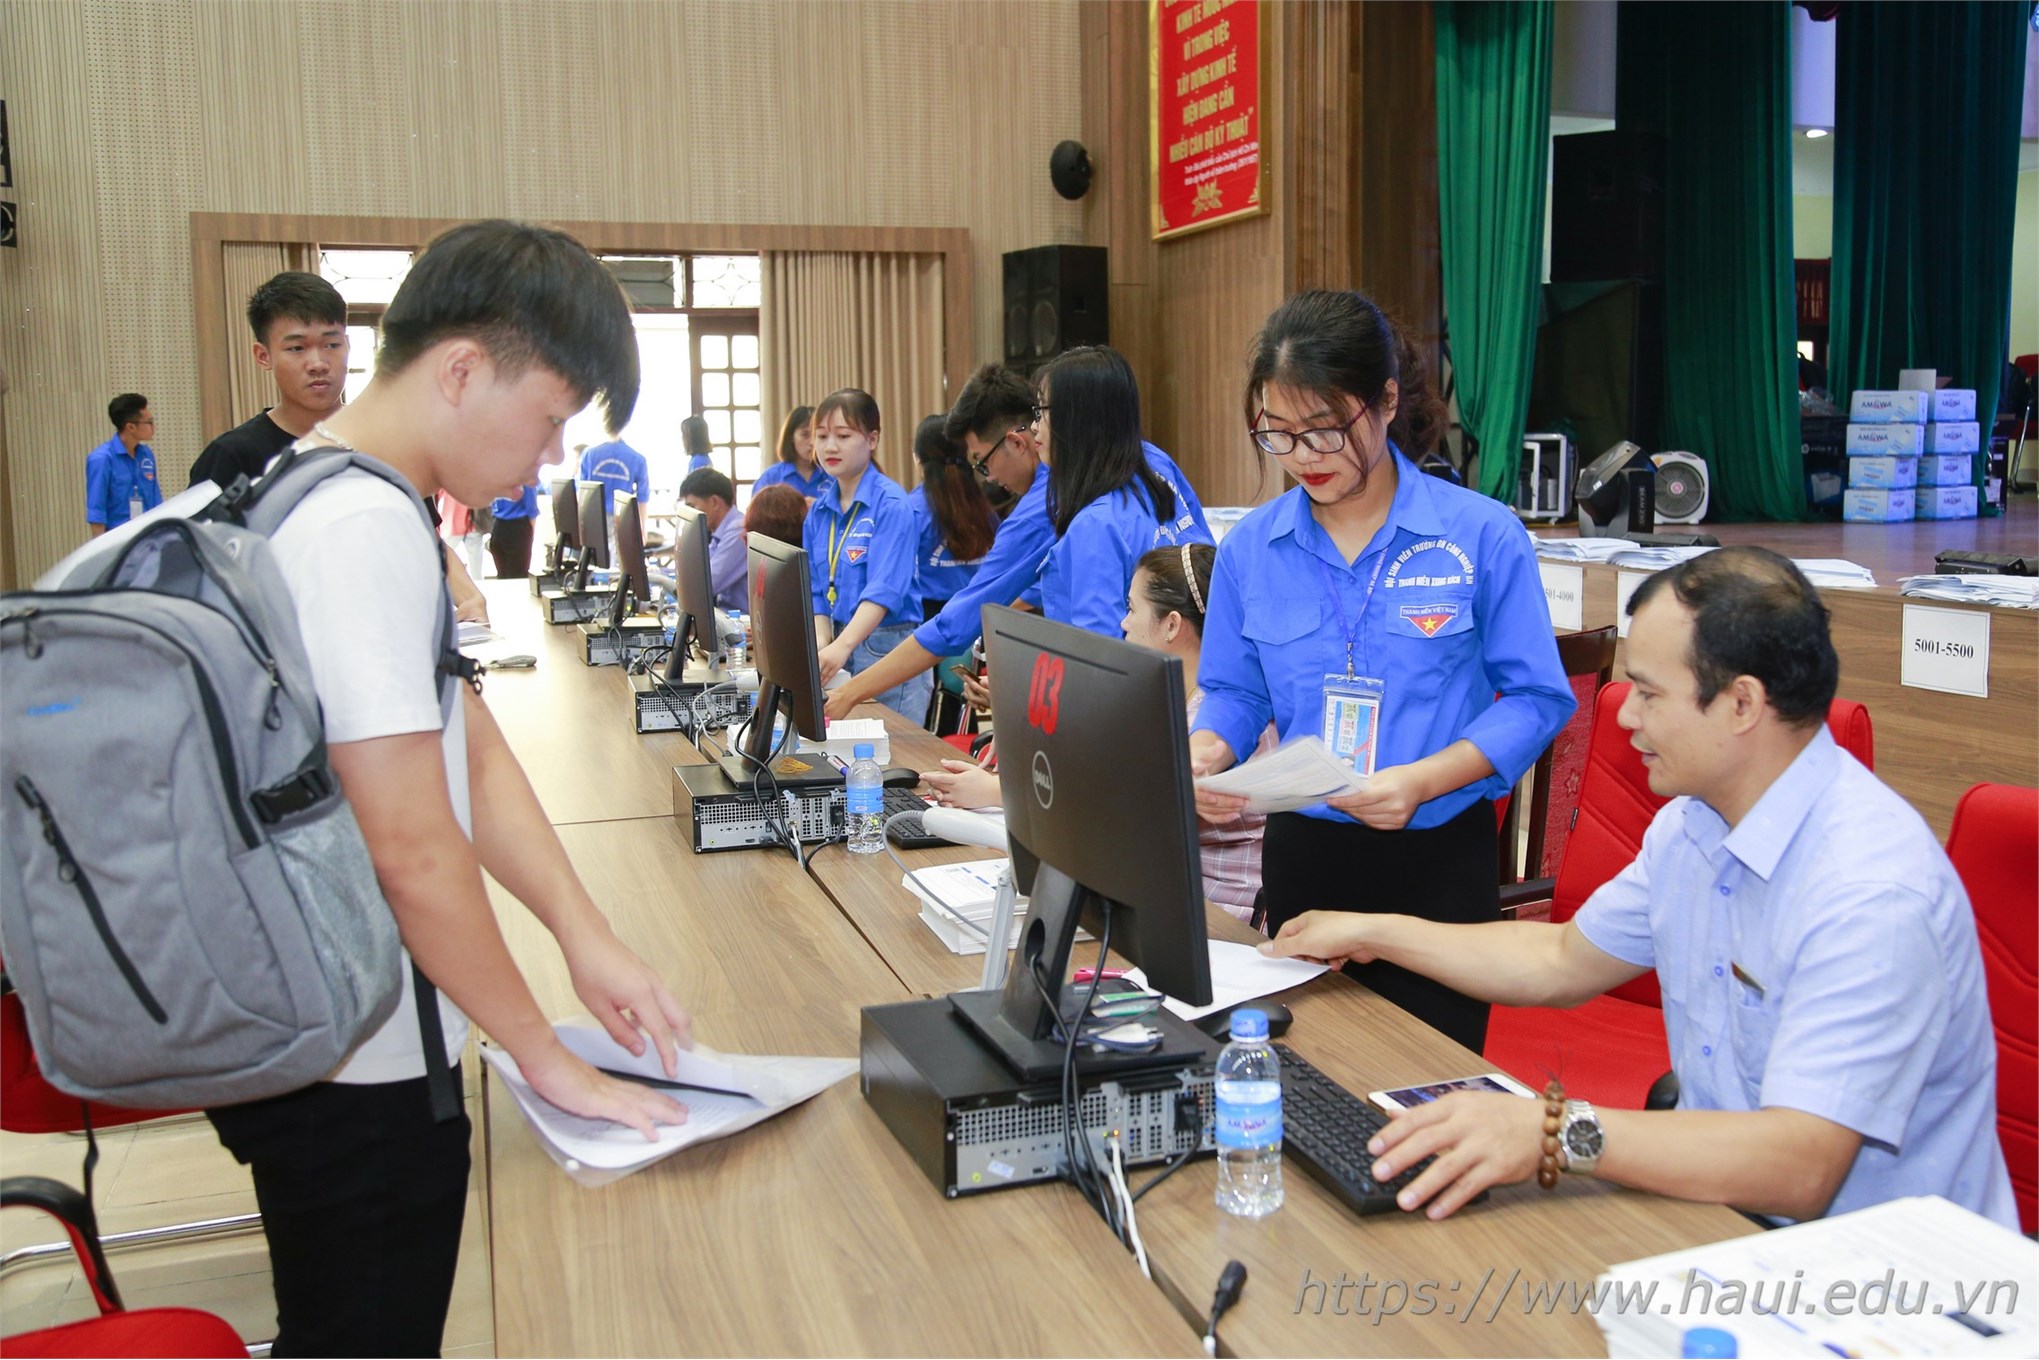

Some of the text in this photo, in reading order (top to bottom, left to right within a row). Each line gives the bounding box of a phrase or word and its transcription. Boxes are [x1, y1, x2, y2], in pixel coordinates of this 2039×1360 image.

[1397, 547, 1413, 564] VIÊN
[1445, 542, 1462, 558] CÔNG
[1545, 588, 1574, 602] 501-4000
[1914, 638, 1974, 659] 5001-5500
[1028, 652, 1065, 736] 03
